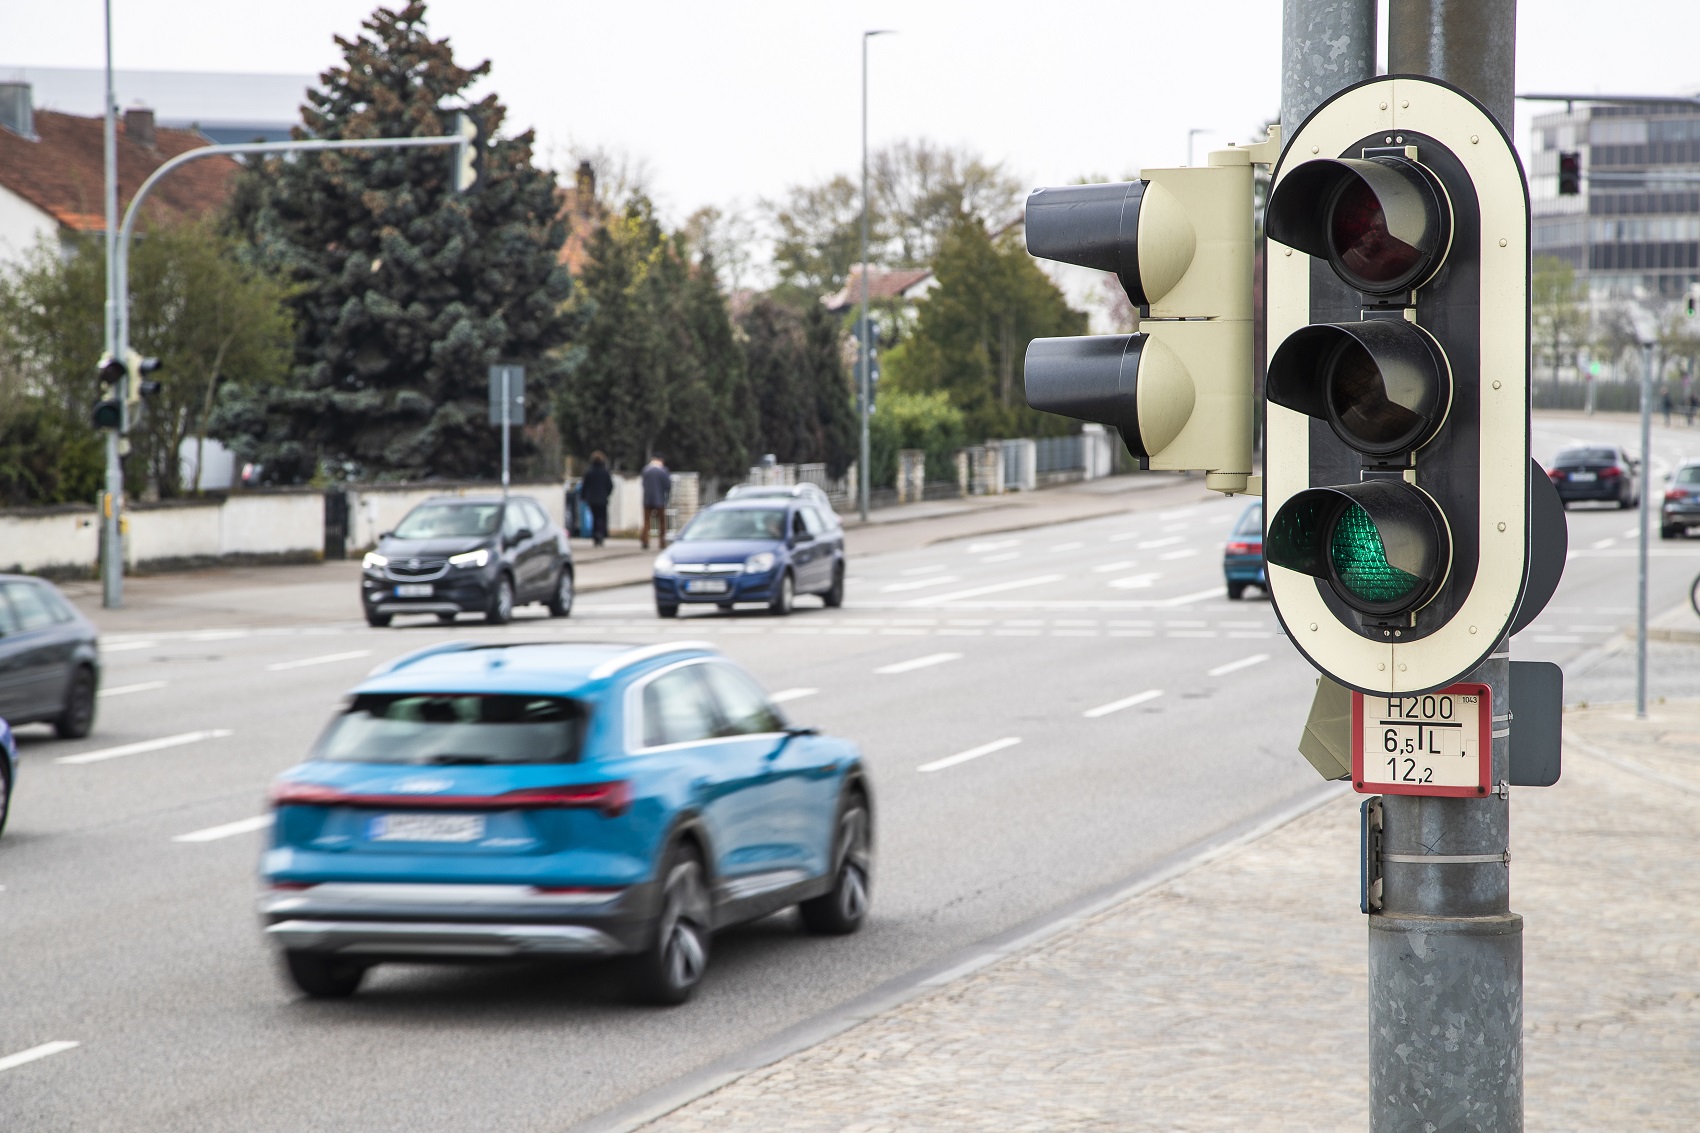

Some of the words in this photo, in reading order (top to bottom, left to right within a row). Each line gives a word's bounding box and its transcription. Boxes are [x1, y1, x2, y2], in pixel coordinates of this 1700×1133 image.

[1387, 696, 1453, 719] H200
[1462, 696, 1478, 704] 1043
[1384, 728, 1414, 755] 6,5
[1387, 757, 1433, 784] 12,2
